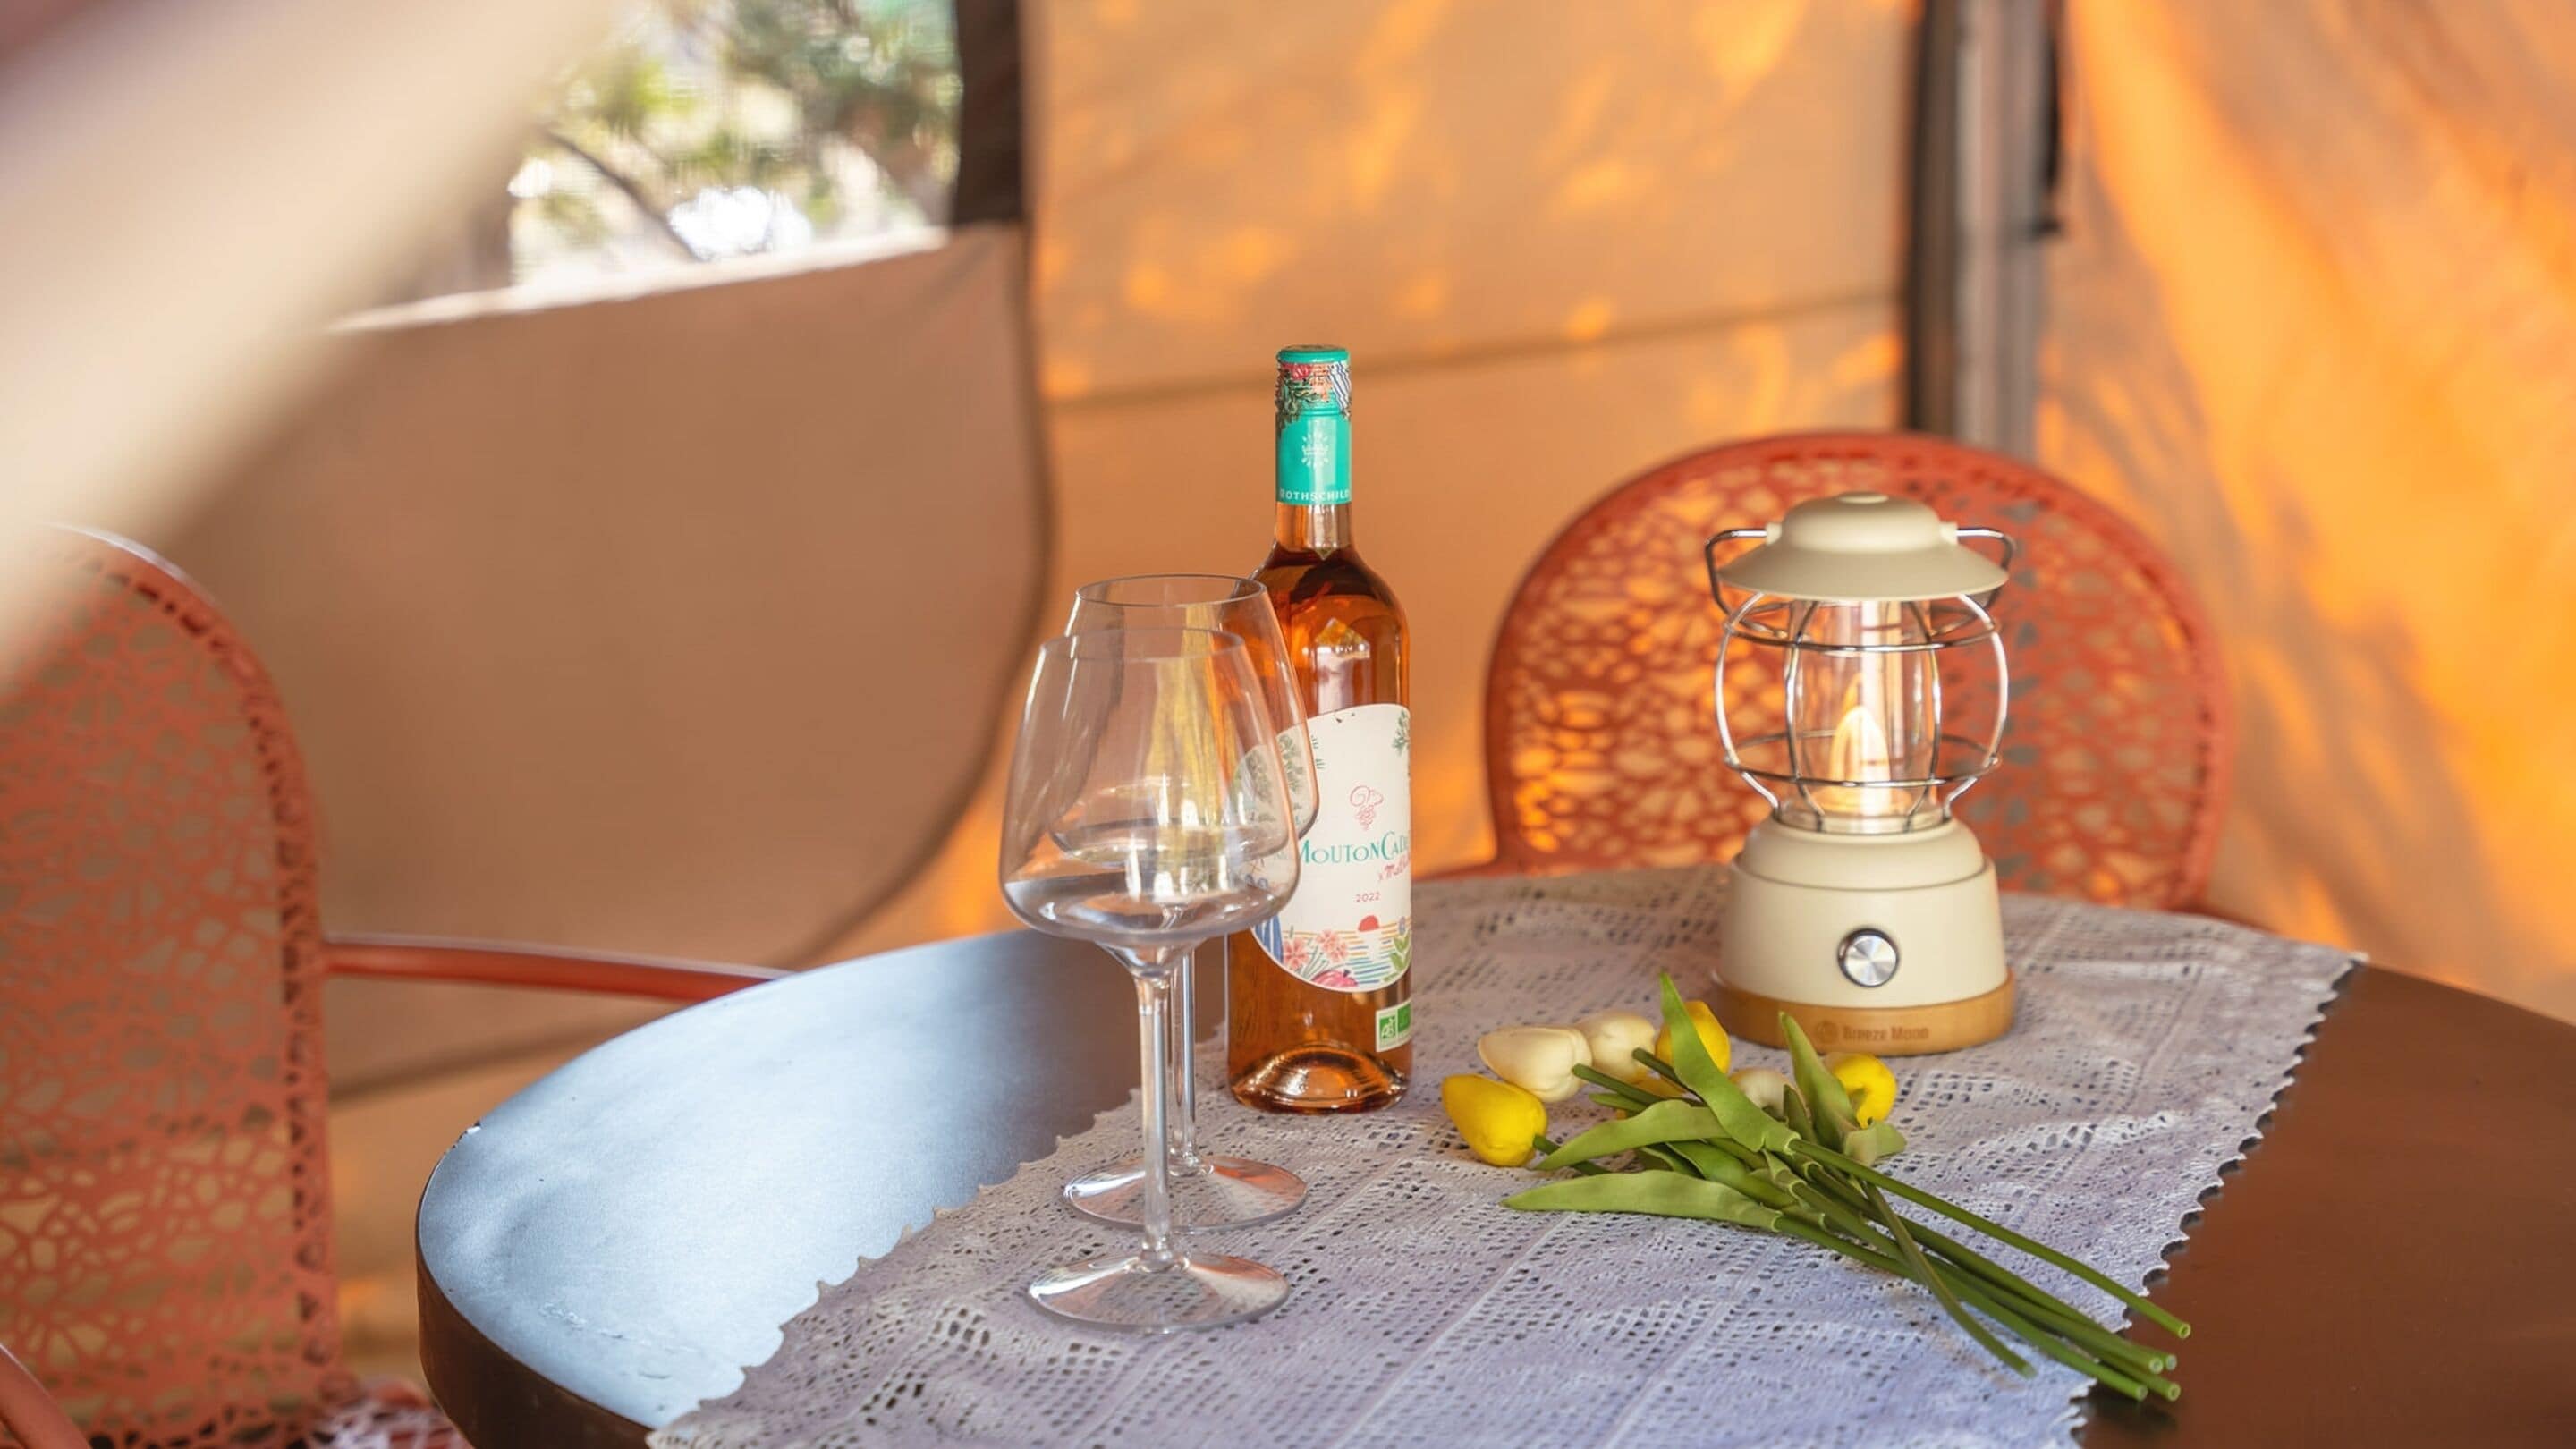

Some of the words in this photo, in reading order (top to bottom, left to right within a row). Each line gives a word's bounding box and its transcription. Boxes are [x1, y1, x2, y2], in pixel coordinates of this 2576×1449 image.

[1355, 891, 1379, 902] 2022
[1843, 1024, 1887, 1041] Breeze
[1891, 1026, 1928, 1039] Moon
